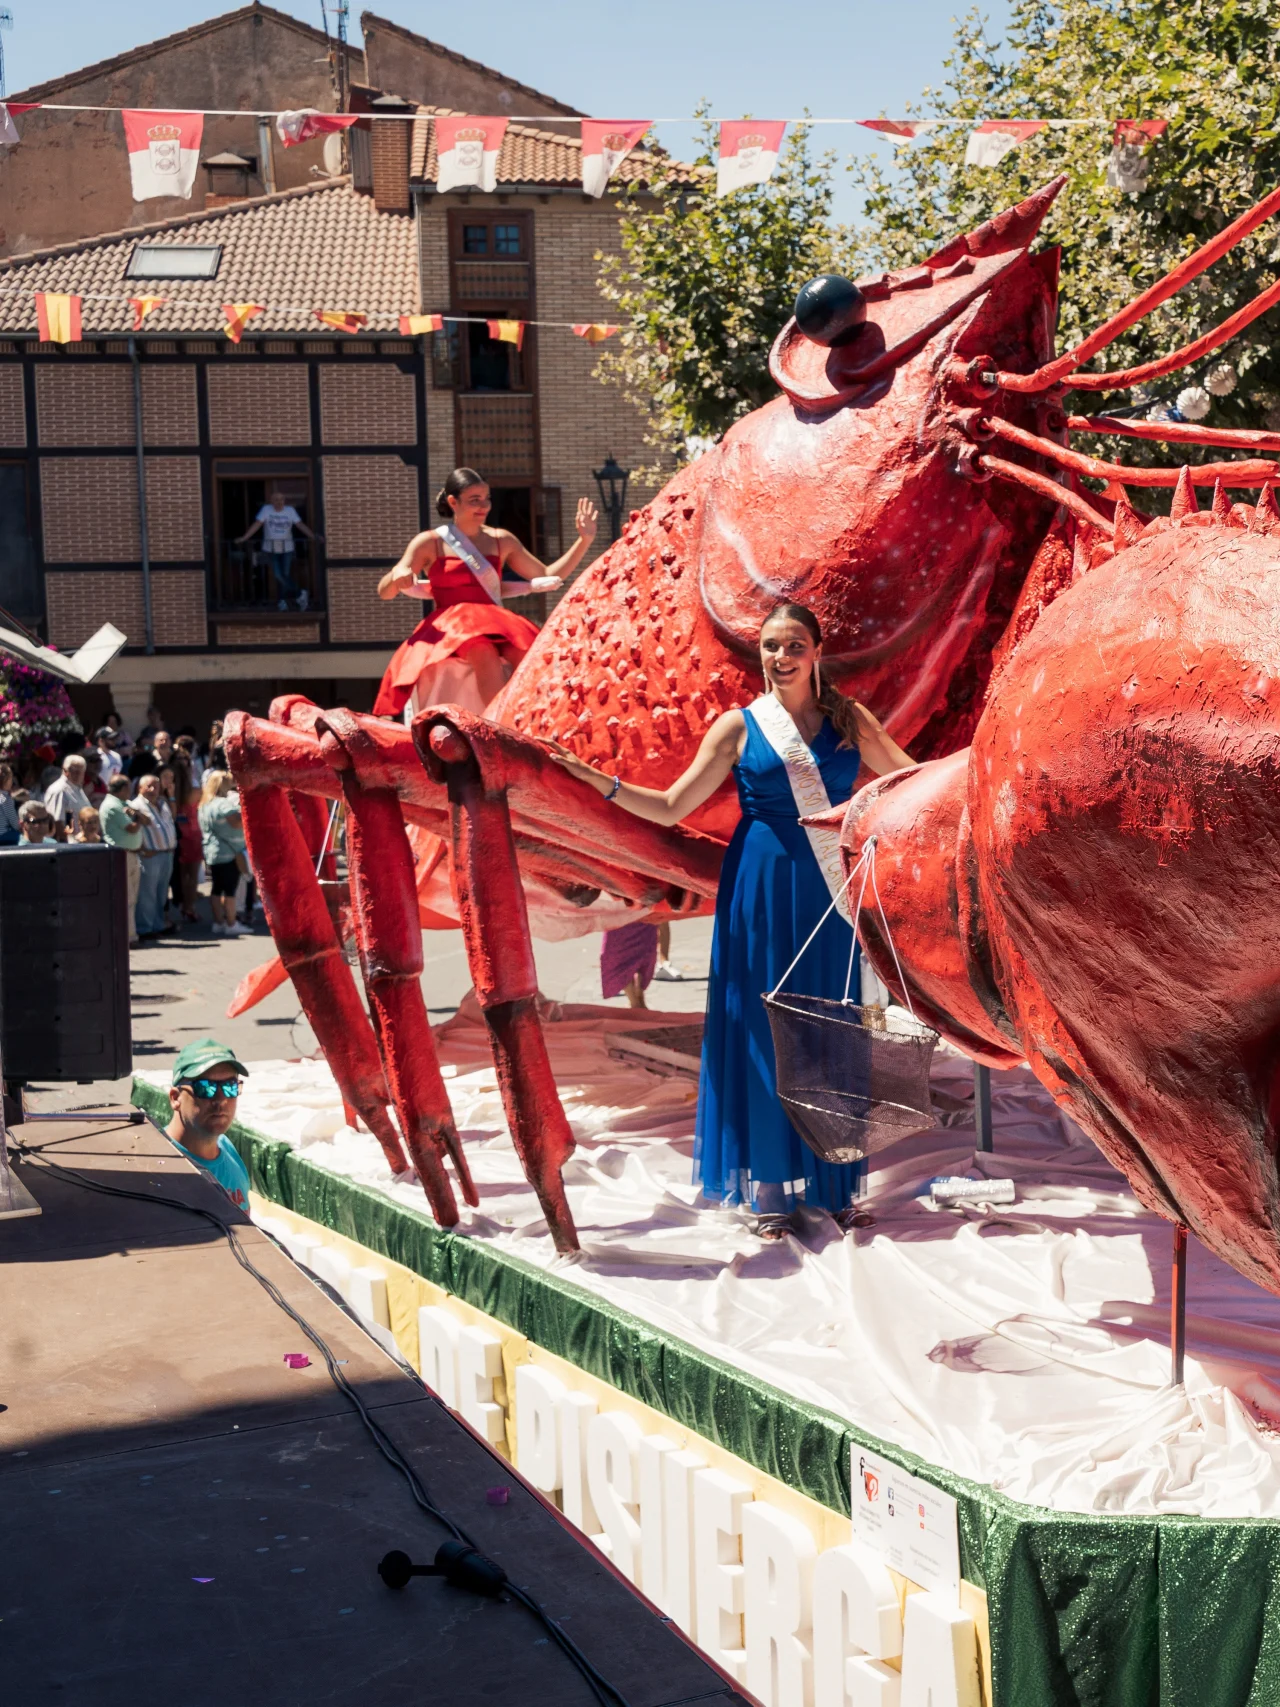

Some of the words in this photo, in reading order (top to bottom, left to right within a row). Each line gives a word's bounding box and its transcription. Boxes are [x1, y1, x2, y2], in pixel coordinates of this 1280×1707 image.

[784, 742, 818, 789] TURISMO
[802, 791, 824, 807] 50
[419, 1305, 503, 1442] DE
